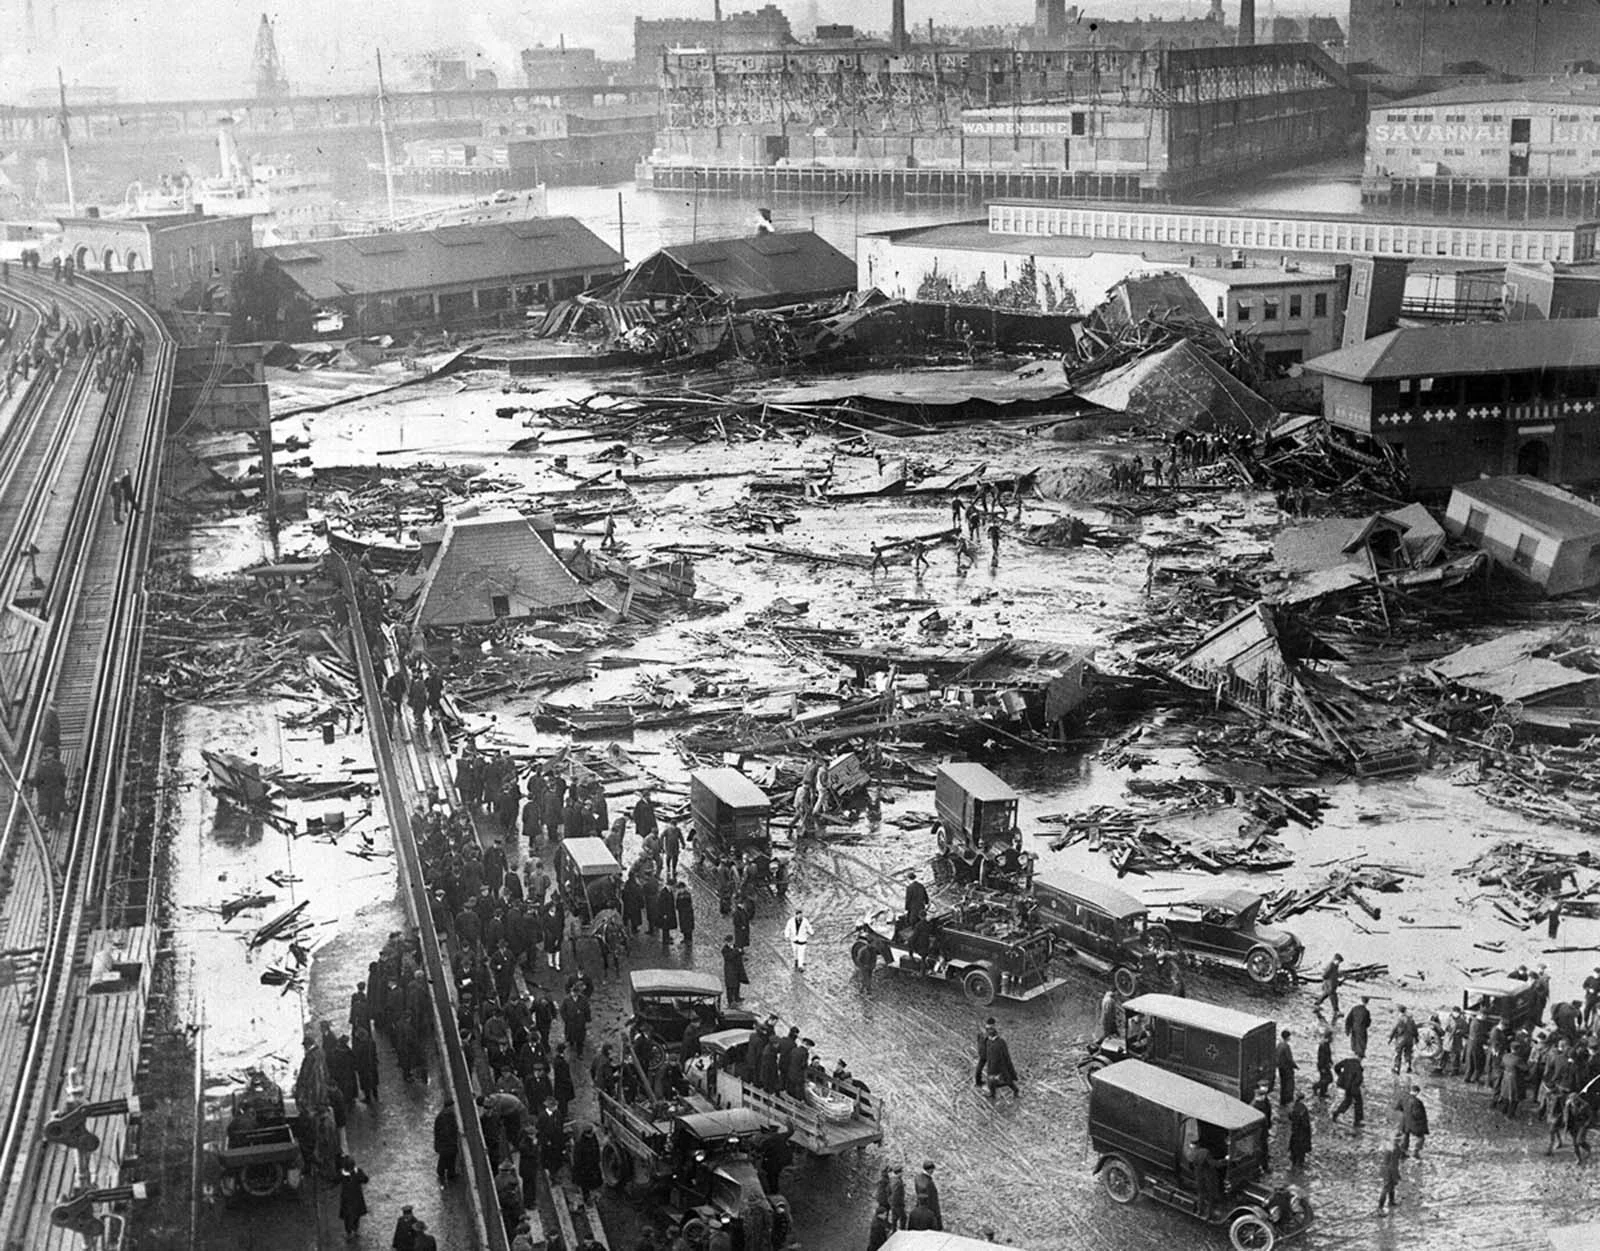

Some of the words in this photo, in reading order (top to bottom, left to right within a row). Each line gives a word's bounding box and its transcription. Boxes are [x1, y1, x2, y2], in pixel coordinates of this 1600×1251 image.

[961, 122, 1024, 134] WARREN
[1030, 122, 1068, 134] LINE
[1374, 124, 1510, 142] SAVANNAH
[1551, 124, 1600, 142] LIN
